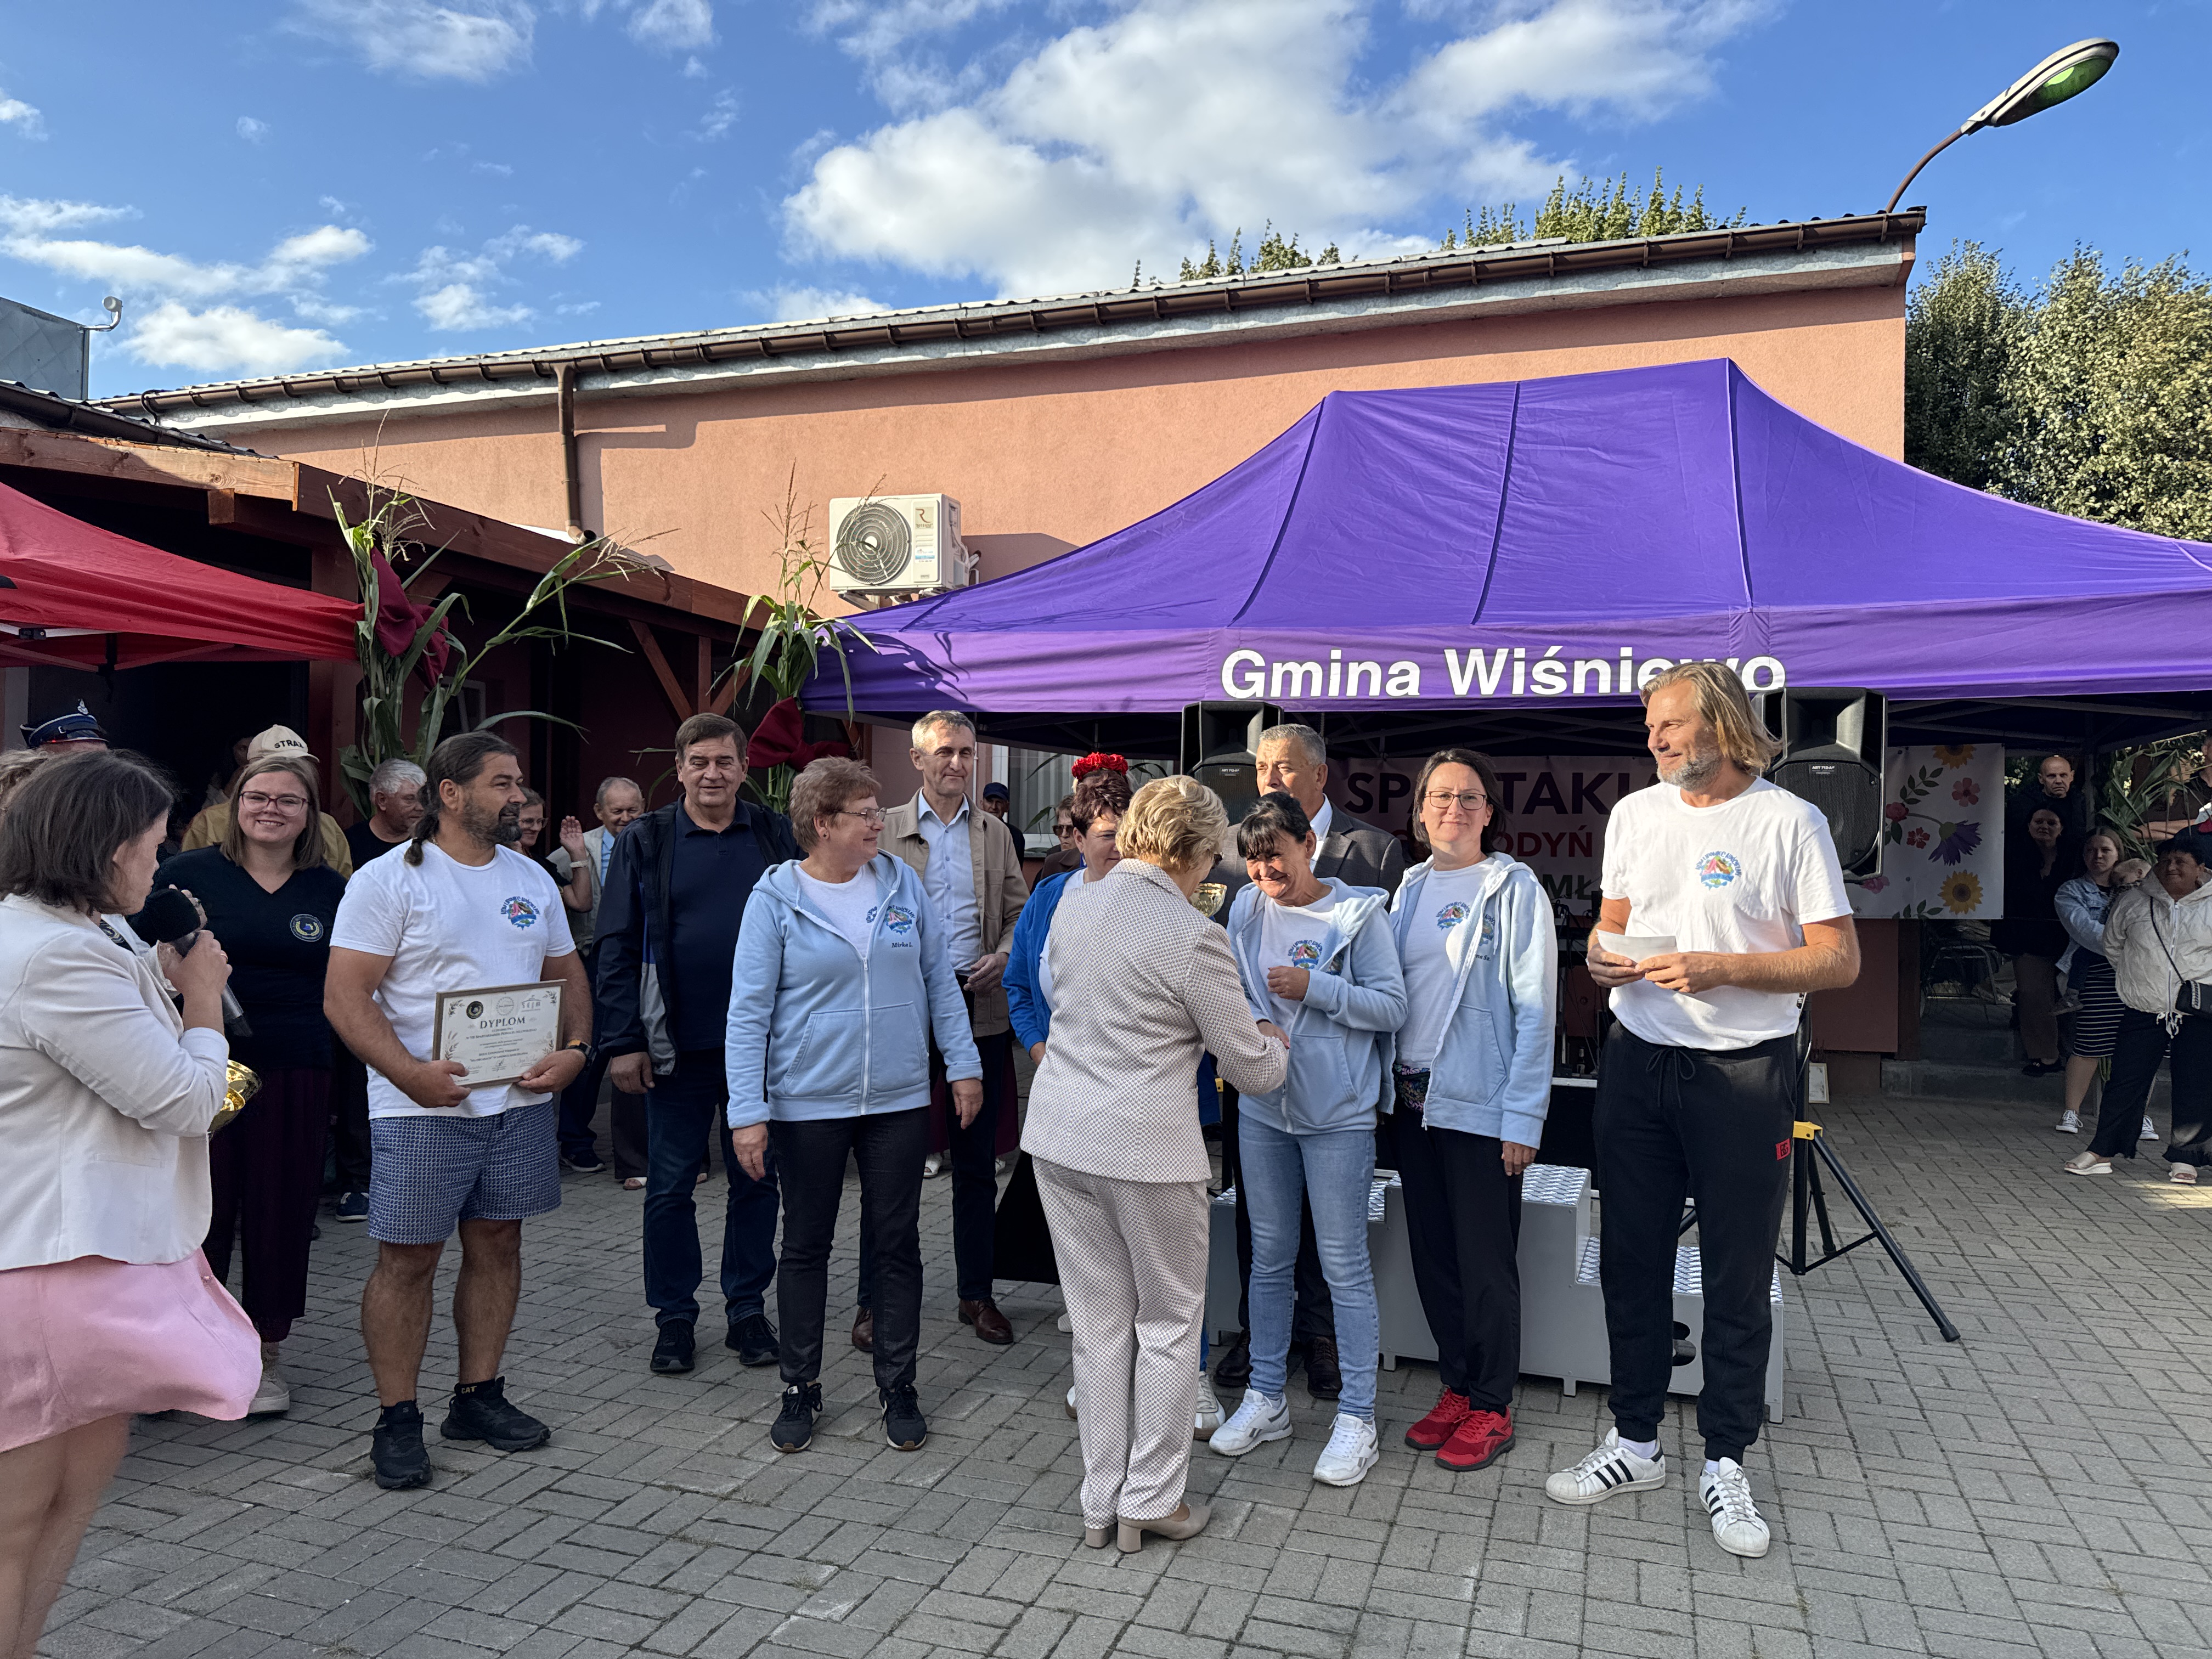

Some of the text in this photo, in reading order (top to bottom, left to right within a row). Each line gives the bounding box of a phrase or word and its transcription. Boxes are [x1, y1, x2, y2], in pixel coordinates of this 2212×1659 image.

[1222, 646, 1786, 699] Gmina Wiśnieo
[480, 1017, 525, 1029] DYPLOM
[461, 1385, 477, 1394] CAT
